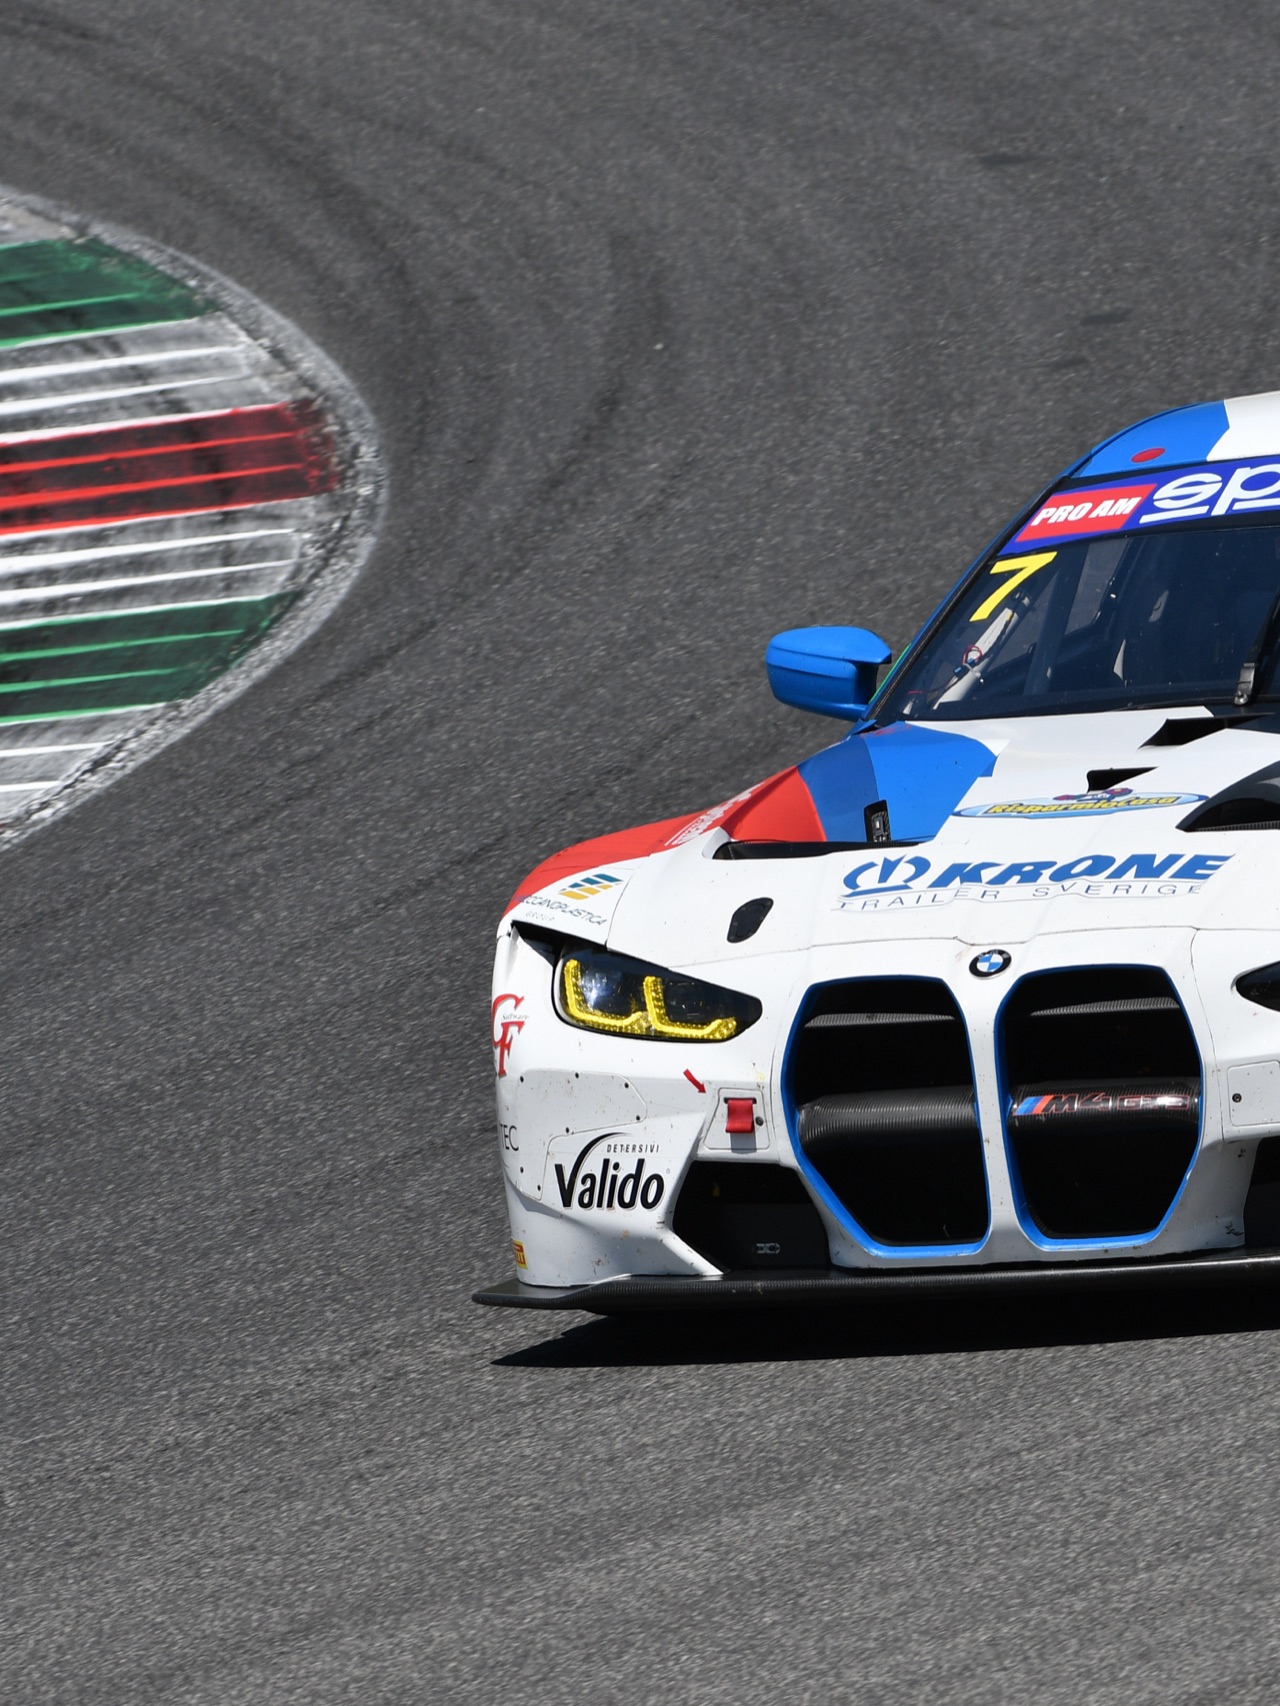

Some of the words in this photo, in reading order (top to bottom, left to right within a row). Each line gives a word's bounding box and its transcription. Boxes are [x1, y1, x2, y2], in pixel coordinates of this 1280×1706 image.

[1030, 502, 1094, 527] PRO
[1088, 496, 1143, 519] AM
[968, 550, 1058, 623] 7
[928, 853, 1237, 888] KRONE
[839, 886, 1000, 911] TRAILER
[1031, 880, 1202, 900] SVERIGE
[499, 1123, 520, 1152] TEC
[606, 1143, 660, 1154] DETERSIVI
[554, 1132, 667, 1210] Valido
